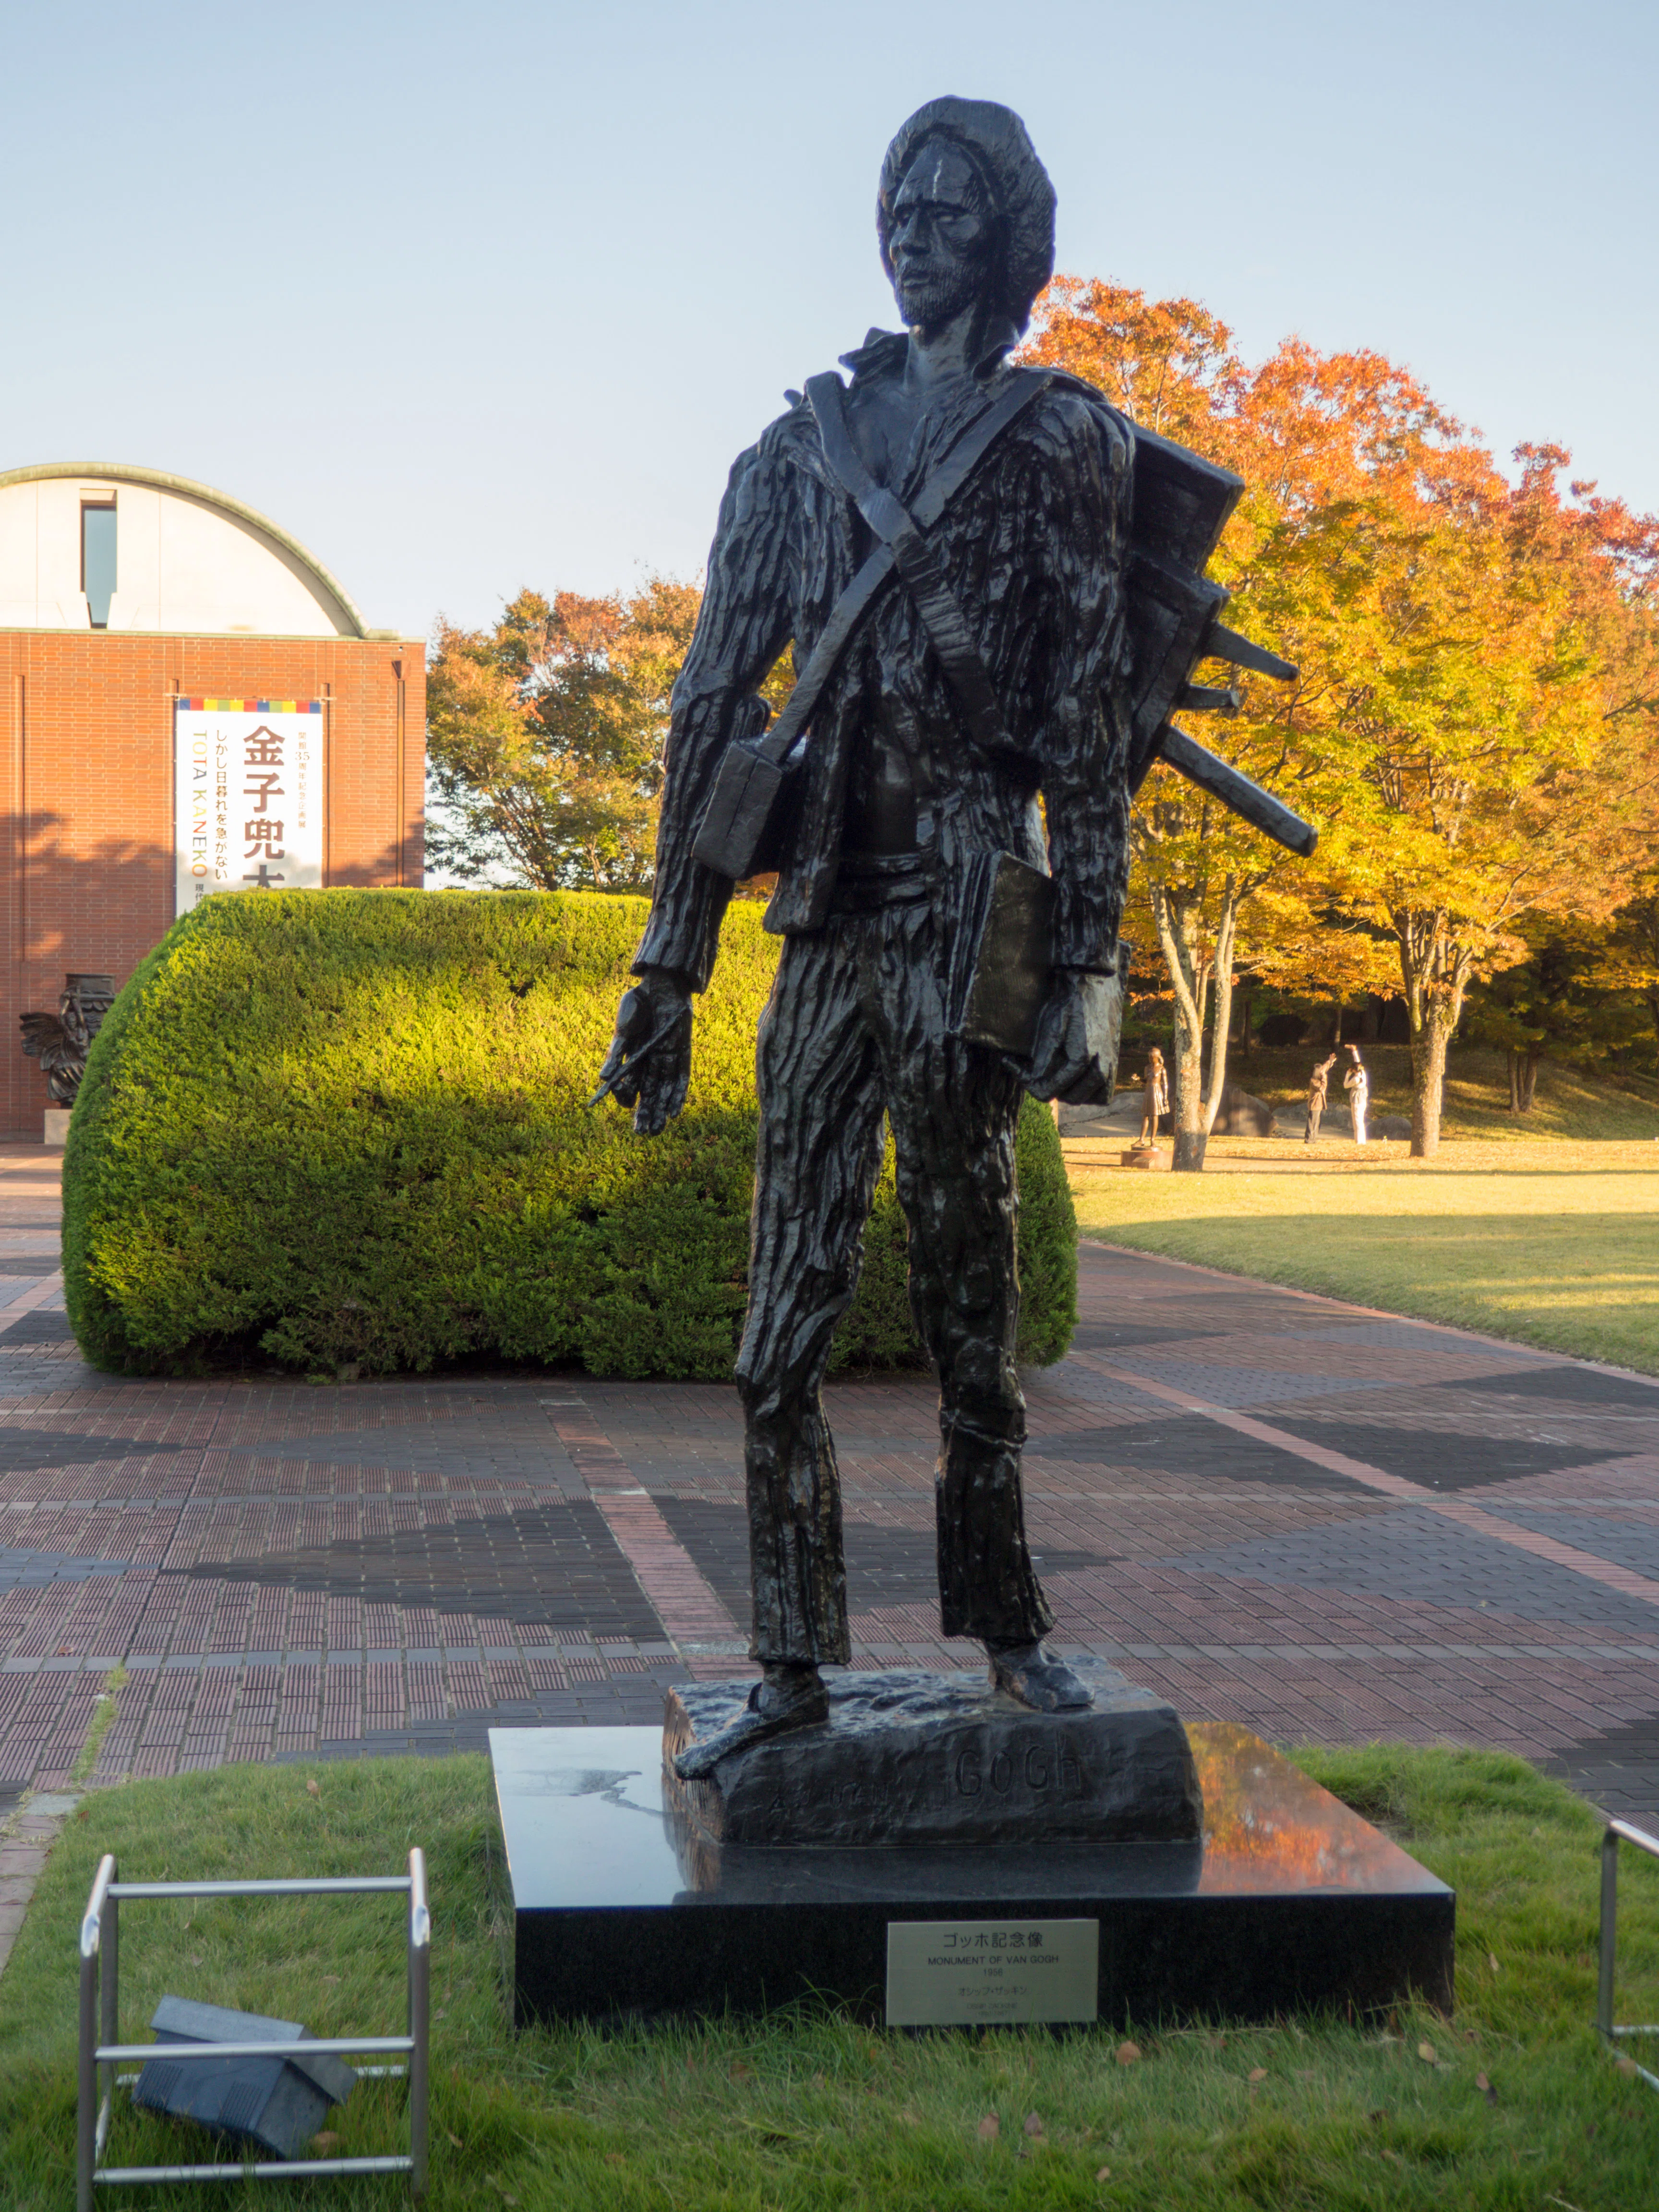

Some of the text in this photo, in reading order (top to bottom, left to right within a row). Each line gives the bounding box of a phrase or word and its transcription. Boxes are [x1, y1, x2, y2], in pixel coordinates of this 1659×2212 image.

[192, 730, 207, 878] TOTA KANEKO
[215, 729, 228, 880] しかし日暮れを急がない
[943, 1931, 1043, 1948] ゴッホ記念像
[927, 1955, 1059, 1966] MONUMENT OF VAN GOGH
[983, 1968, 1003, 1977] 1956
